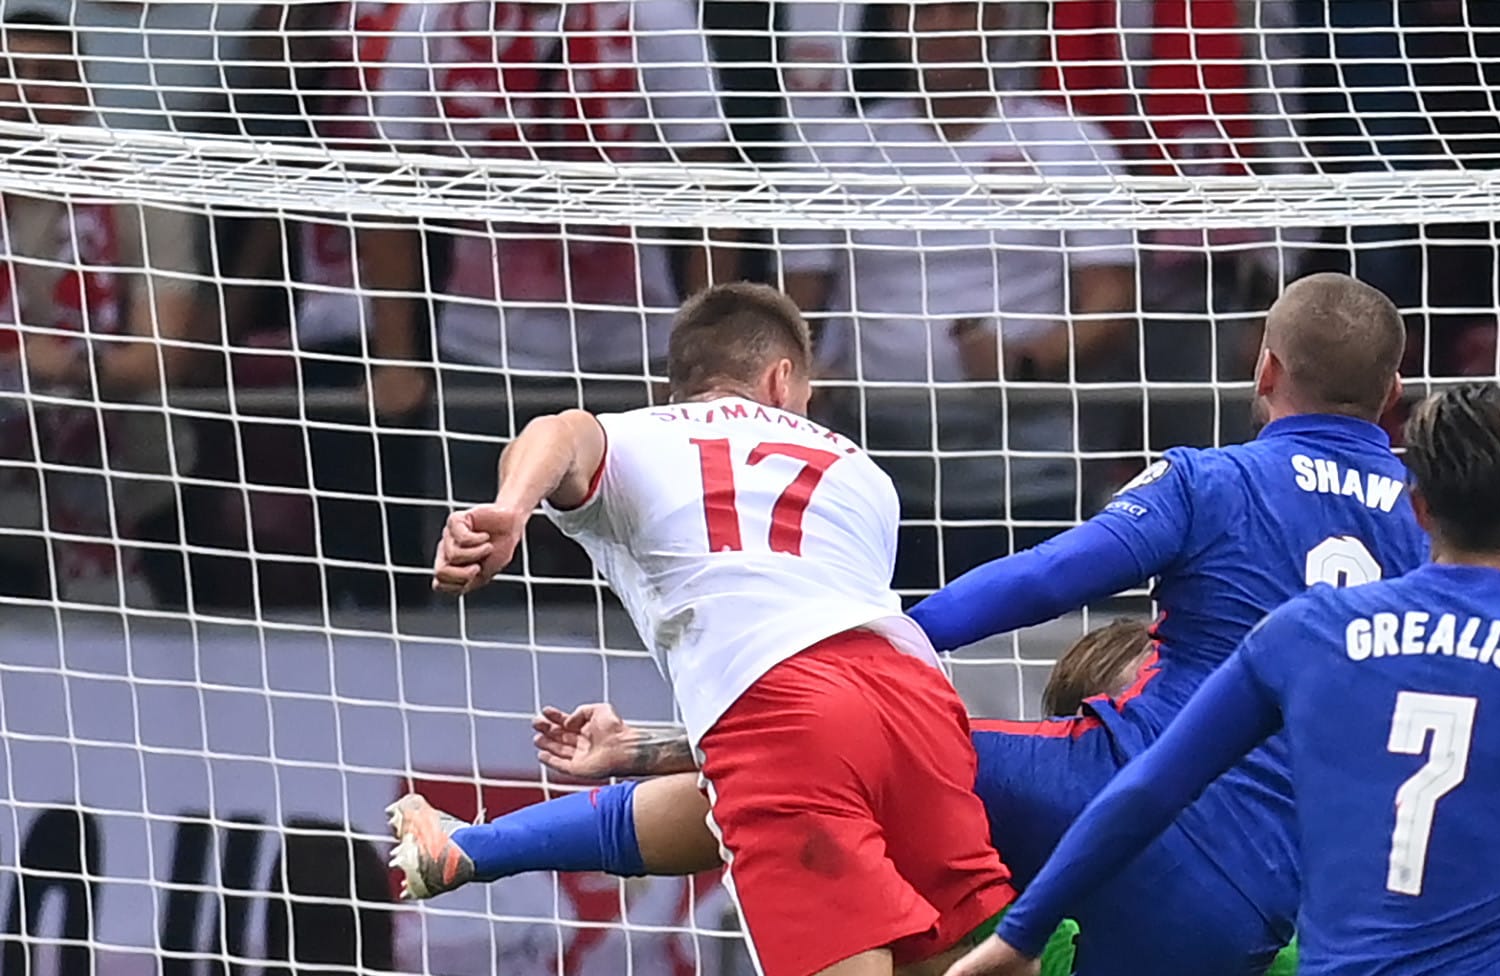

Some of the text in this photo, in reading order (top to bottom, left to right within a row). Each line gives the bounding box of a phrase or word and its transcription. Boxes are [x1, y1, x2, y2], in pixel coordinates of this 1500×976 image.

[688, 437, 842, 558] 17
[1290, 454, 1404, 513] SHAW
[1386, 689, 1479, 897] 7
